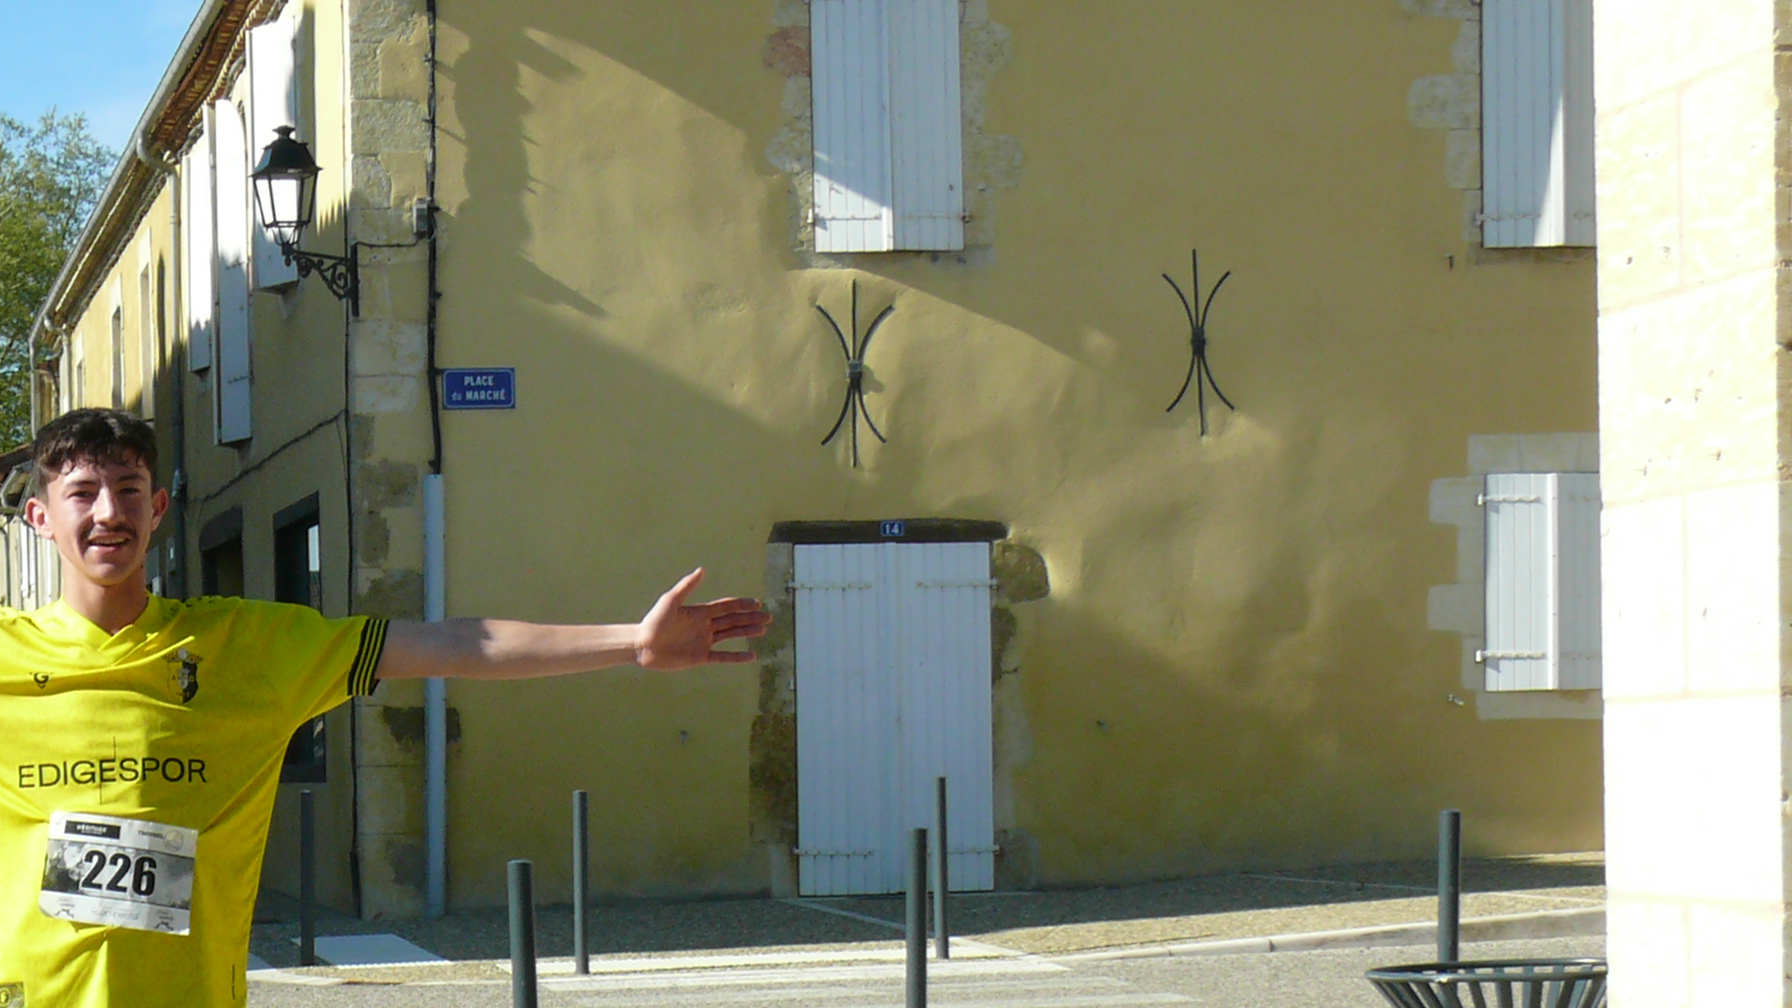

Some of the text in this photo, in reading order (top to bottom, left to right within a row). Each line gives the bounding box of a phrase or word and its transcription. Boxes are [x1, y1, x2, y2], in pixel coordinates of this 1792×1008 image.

[464, 375, 494, 387] PLACE
[452, 388, 506, 401] du MARCHÉ
[884, 523, 899, 535] 14
[18, 757, 207, 789] EDIGESPOR
[81, 849, 157, 897] 226
